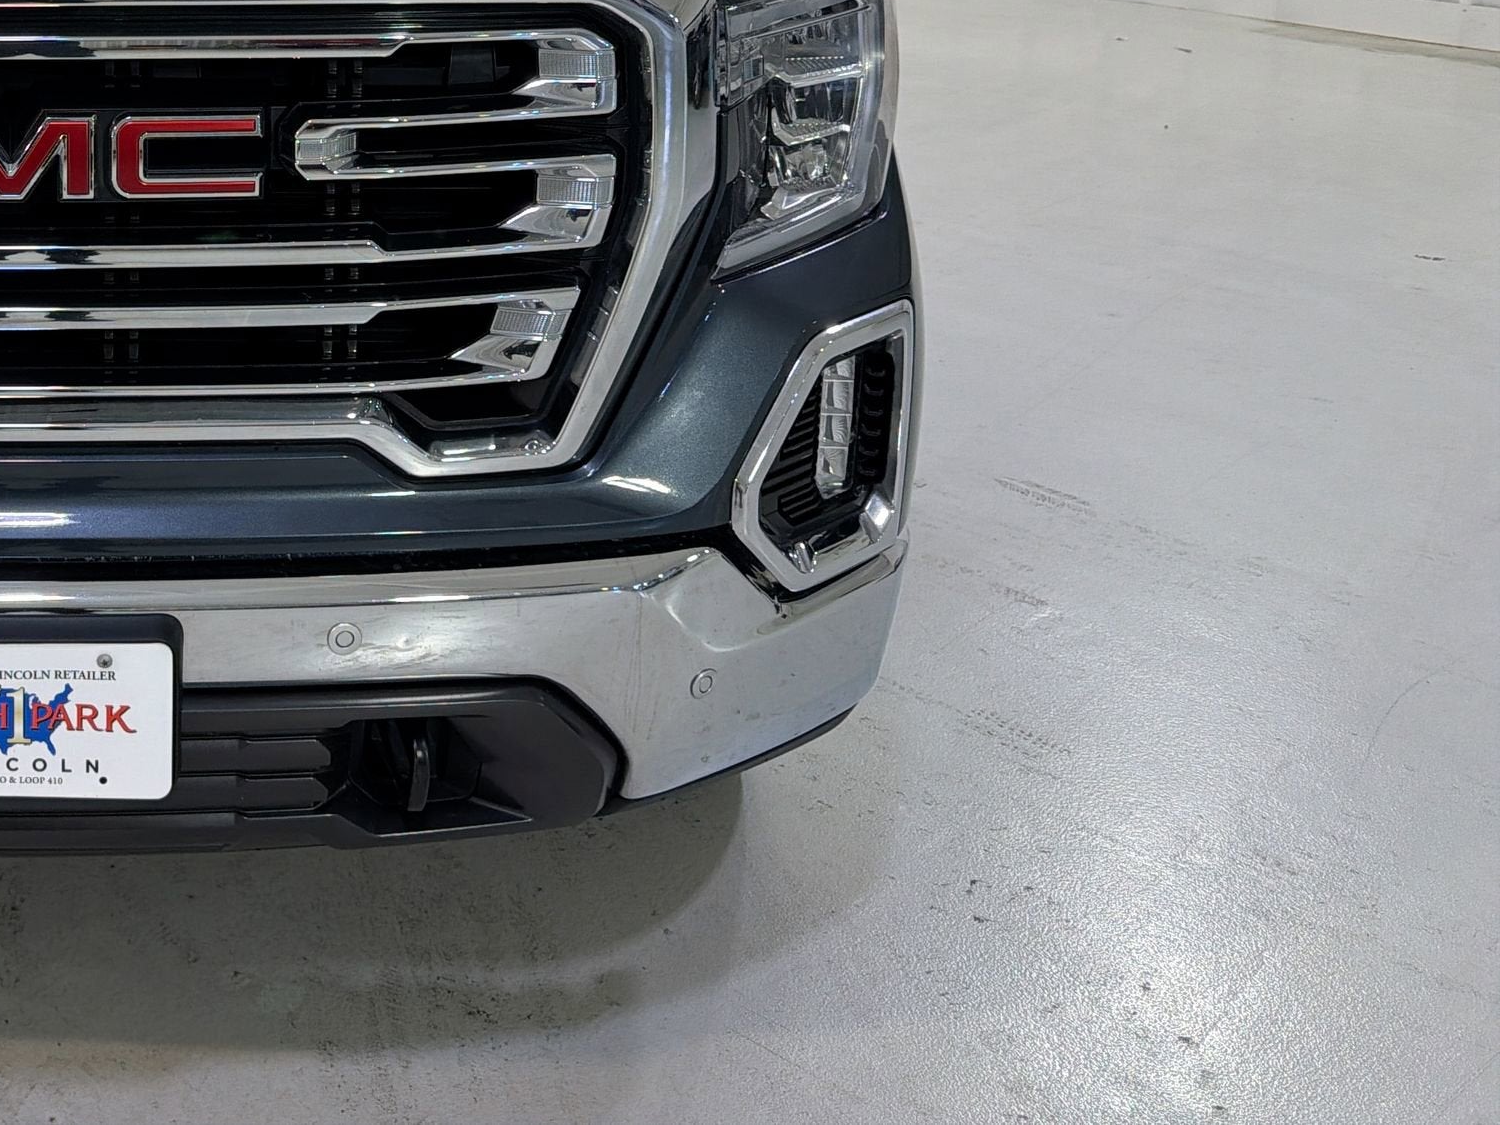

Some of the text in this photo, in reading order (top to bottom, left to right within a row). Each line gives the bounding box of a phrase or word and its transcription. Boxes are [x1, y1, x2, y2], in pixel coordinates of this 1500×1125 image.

[54, 670, 117, 682] RETAILER
[30, 702, 138, 734] PARK
[8, 776, 17, 785] &
[19, 776, 46, 785] LOOP
[47, 776, 64, 786] 410
